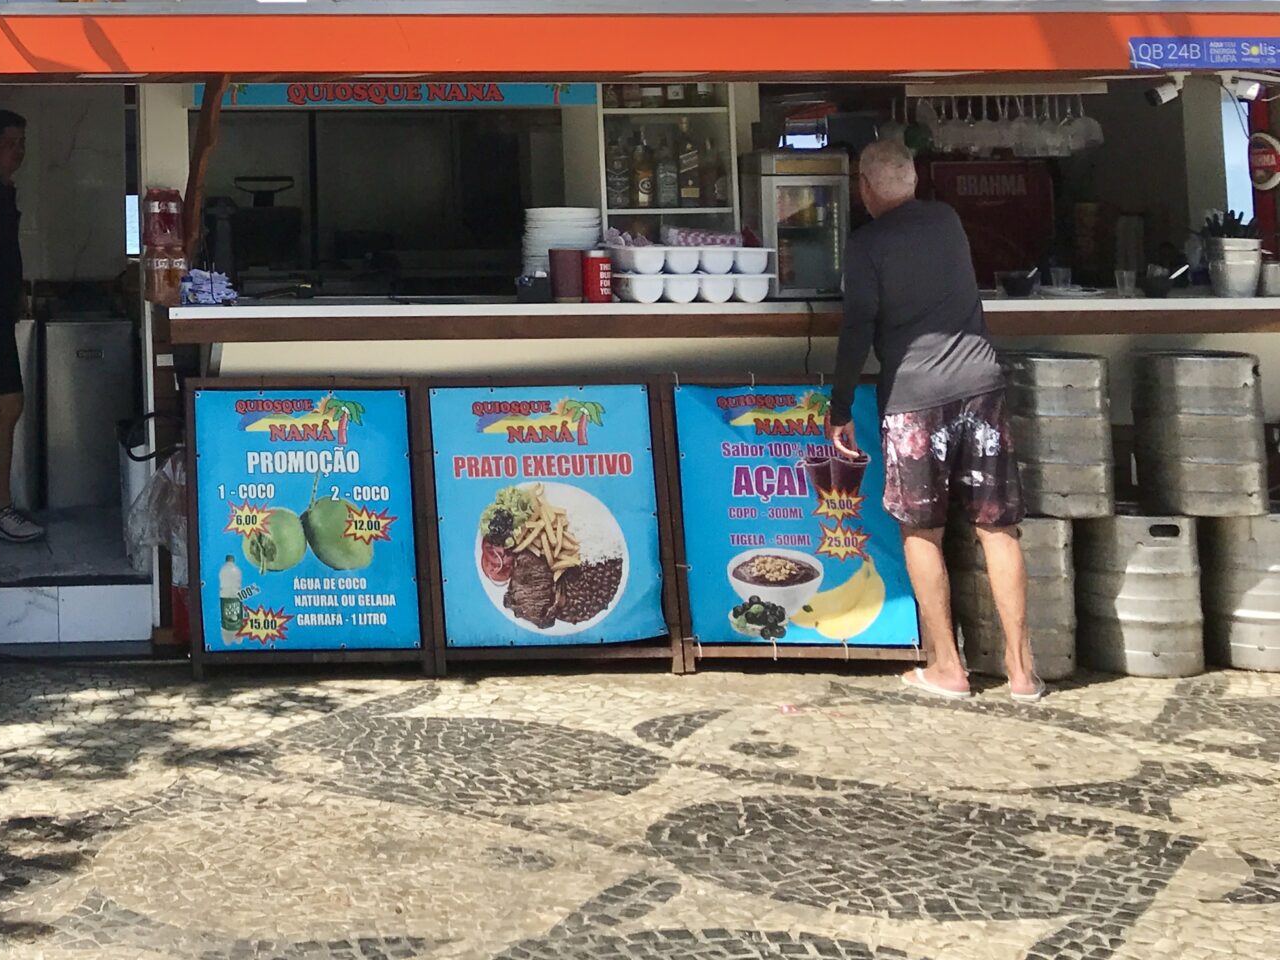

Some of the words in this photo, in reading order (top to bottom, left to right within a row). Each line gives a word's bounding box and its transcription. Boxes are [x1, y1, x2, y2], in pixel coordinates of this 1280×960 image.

[1140, 43, 1163, 61] QB
[1168, 43, 1200, 59] 24B
[287, 83, 422, 105] QUIOSQUE
[235, 399, 314, 414] QUIOSQUE
[472, 400, 551, 416] QUIOSQUE
[717, 394, 797, 409] QUIOSQUE
[269, 419, 336, 441] NANÁ
[507, 420, 575, 443] NANÁ
[754, 414, 822, 436] NANÁ
[722, 442, 764, 457] Sabor
[768, 443, 803, 457] 100%
[807, 443, 839, 457] Natu
[247, 447, 360, 477] PROMOÇÃO
[453, 455, 517, 478] PRATO
[523, 453, 632, 477] EXECUTIVO
[733, 460, 809, 503] AÇAÍ
[218, 484, 225, 499] 1
[238, 484, 275, 499] COCO
[331, 486, 339, 500] 2
[352, 486, 389, 500] COCO
[825, 499, 853, 511] 15,00
[236, 515, 257, 526] 6,00
[729, 507, 757, 519] COPO
[768, 507, 803, 519] 300ML
[353, 520, 381, 532] 12,00
[730, 534, 765, 545] TIGELA
[776, 533, 811, 545] 500ML
[827, 536, 858, 548] 25,00
[293, 576, 320, 590] ÁGUA
[323, 578, 336, 589] DE
[338, 578, 367, 590] COCO
[237, 583, 261, 601] 100%
[294, 595, 339, 607] NATURAL
[341, 595, 355, 606] OU
[358, 594, 396, 606] GELADA
[249, 618, 277, 630] 15,00
[297, 613, 343, 626] GARRAFA
[351, 613, 357, 625] 1
[359, 613, 387, 625] LITRO
